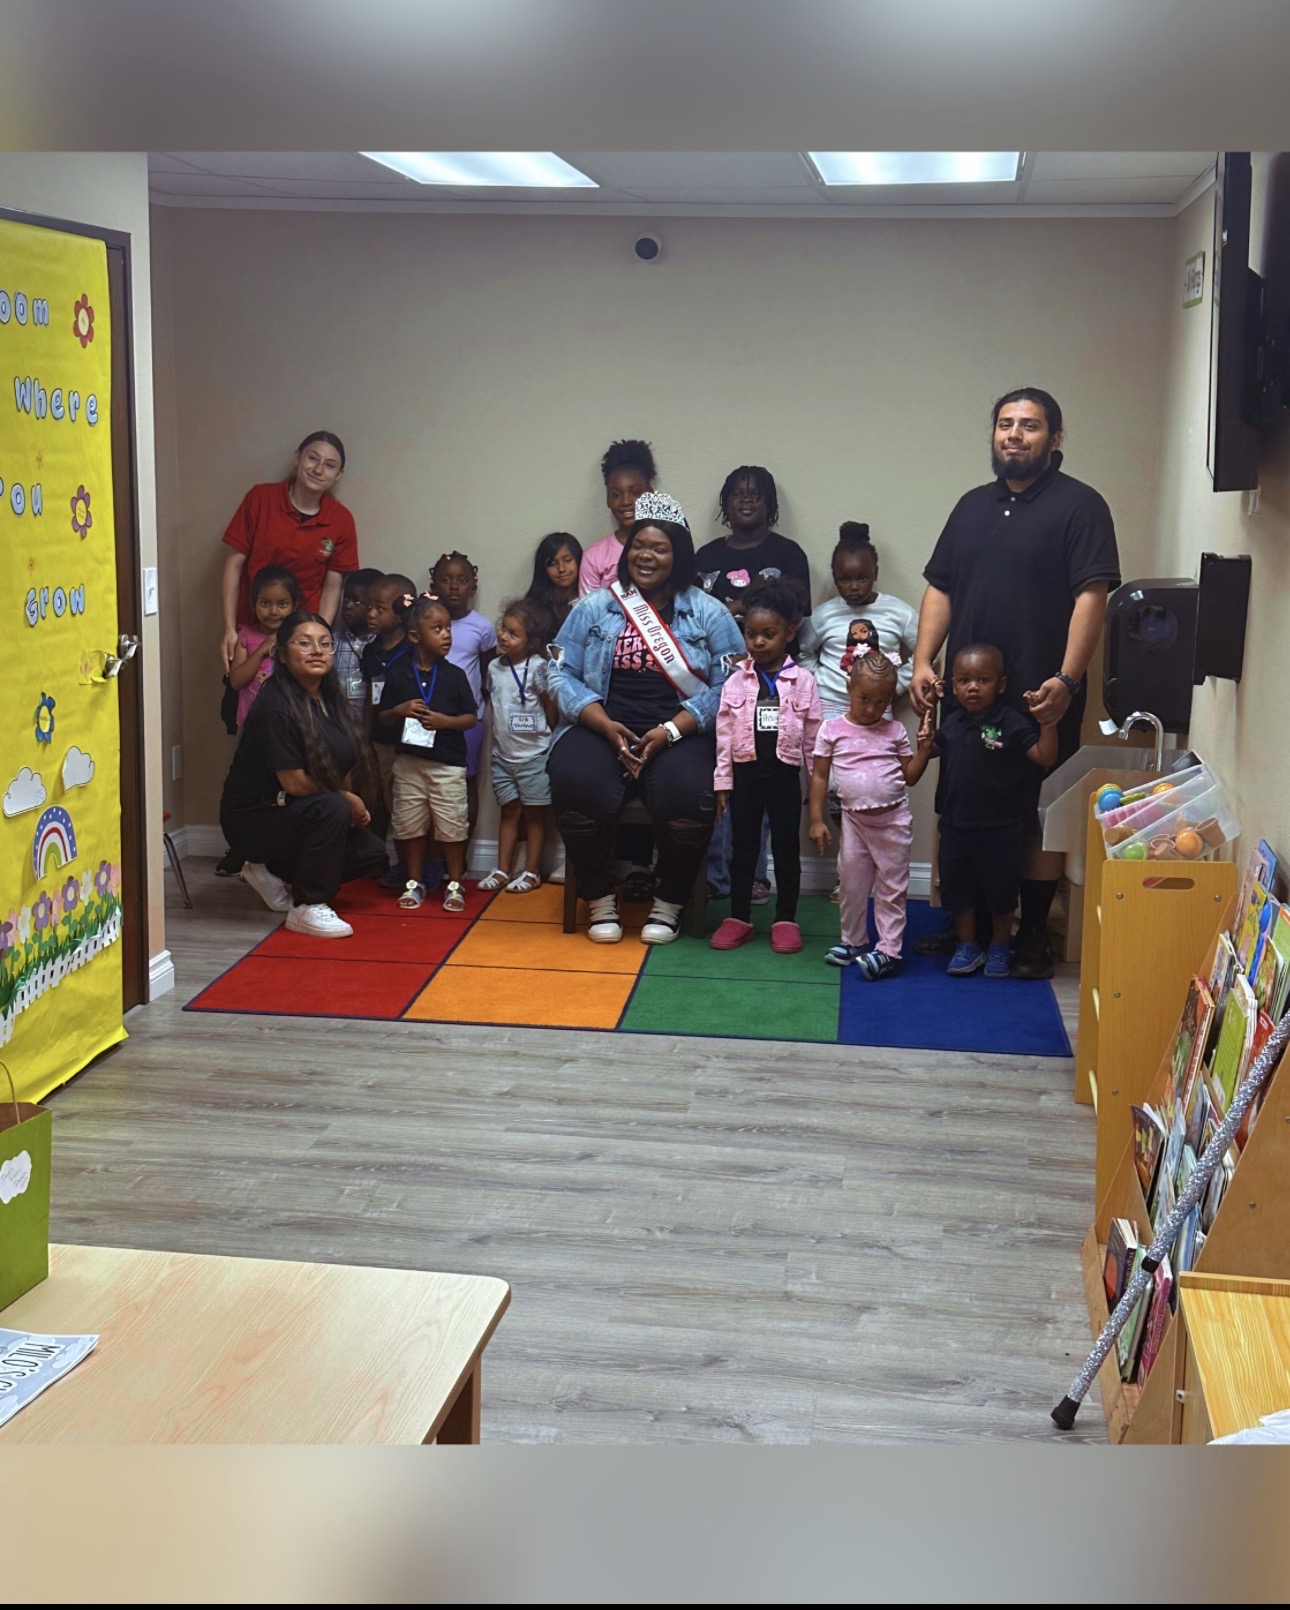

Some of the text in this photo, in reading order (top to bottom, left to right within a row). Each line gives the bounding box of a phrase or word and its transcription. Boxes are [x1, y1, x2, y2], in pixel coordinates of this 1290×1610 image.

[14, 376, 98, 426] Where
[633, 603, 676, 665] Miss Oregon
